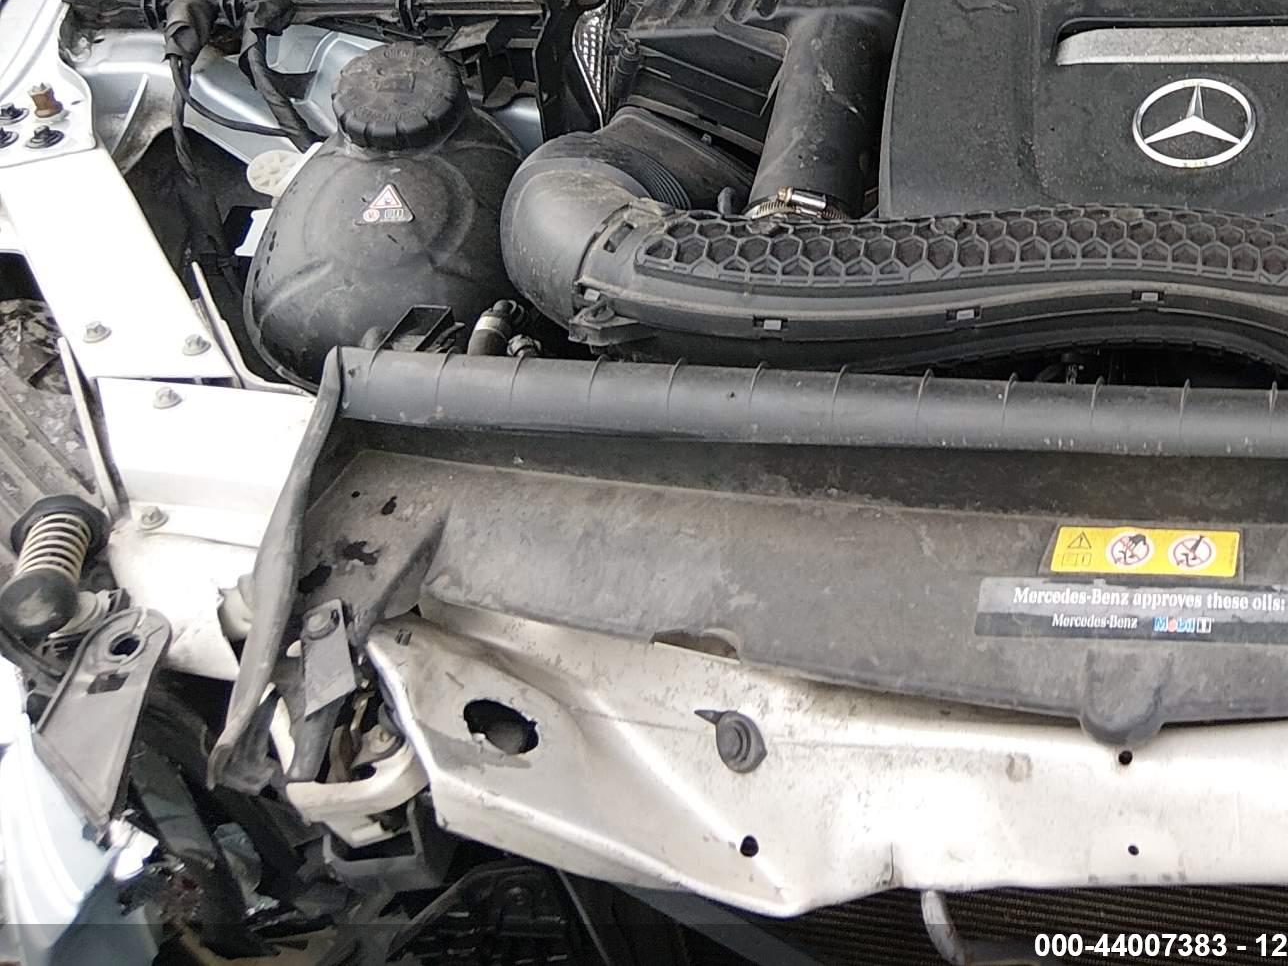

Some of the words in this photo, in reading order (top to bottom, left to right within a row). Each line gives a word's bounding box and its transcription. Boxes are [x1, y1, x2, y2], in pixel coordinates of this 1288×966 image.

[1013, 587, 1129, 607] Mercedes-Benz
[1132, 592, 1202, 610] approves
[1206, 592, 1249, 610] these
[1252, 594, 1286, 611] oils:
[1052, 614, 1138, 629] Mercedes-Benz
[1153, 616, 1196, 633] Mobil
